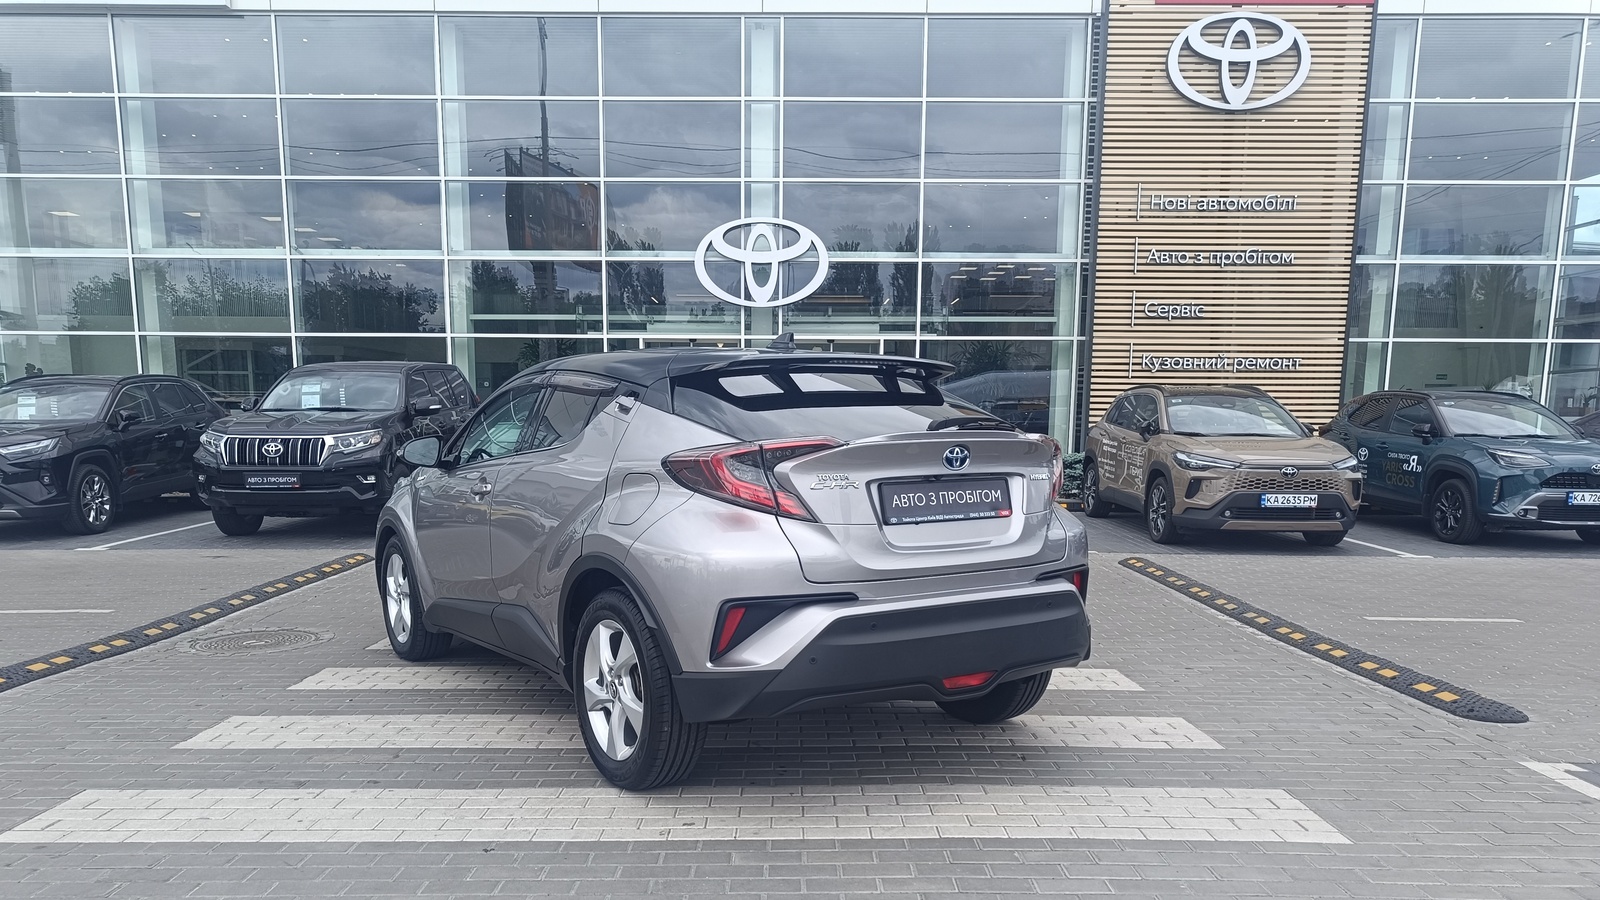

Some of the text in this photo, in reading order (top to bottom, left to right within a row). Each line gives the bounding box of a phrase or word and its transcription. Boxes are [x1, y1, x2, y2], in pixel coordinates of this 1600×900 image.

[1150, 194, 1299, 211] Нові автомобілі
[1146, 248, 1295, 268] Авто з пробігом
[1144, 301, 1205, 321] Сервіс
[1141, 353, 1302, 374] Кузовний ремонт
[1382, 460, 1403, 473] YARIS
[809, 481, 860, 490] C-HR
[817, 473, 850, 482] TOYOTA
[1385, 472, 1416, 488] CROSS
[892, 493, 926, 508] АВТО
[939, 489, 1002, 505] ПРОБІГОМ
[1280, 495, 1302, 505] 2635
